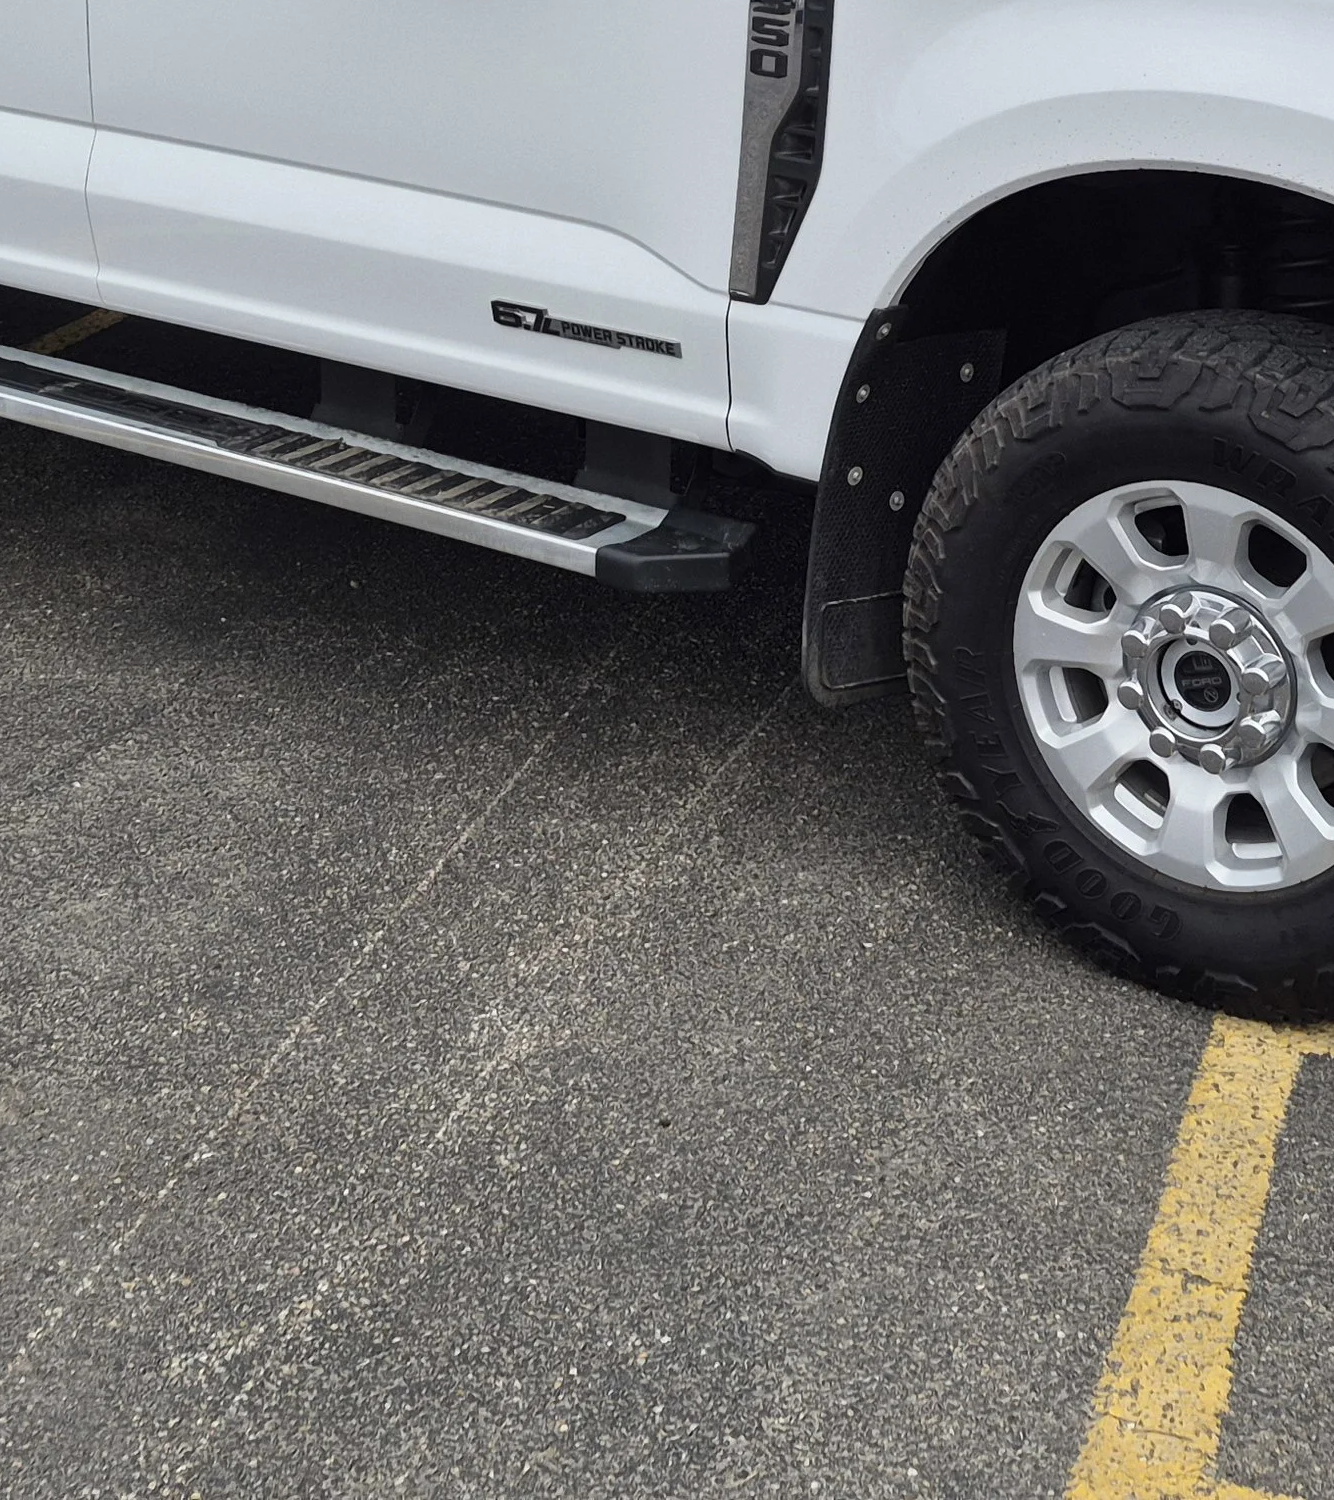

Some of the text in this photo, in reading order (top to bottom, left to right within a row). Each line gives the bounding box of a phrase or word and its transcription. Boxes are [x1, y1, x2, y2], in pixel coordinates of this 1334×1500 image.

[491, 299, 677, 357] 6.7L POWER STROKE
